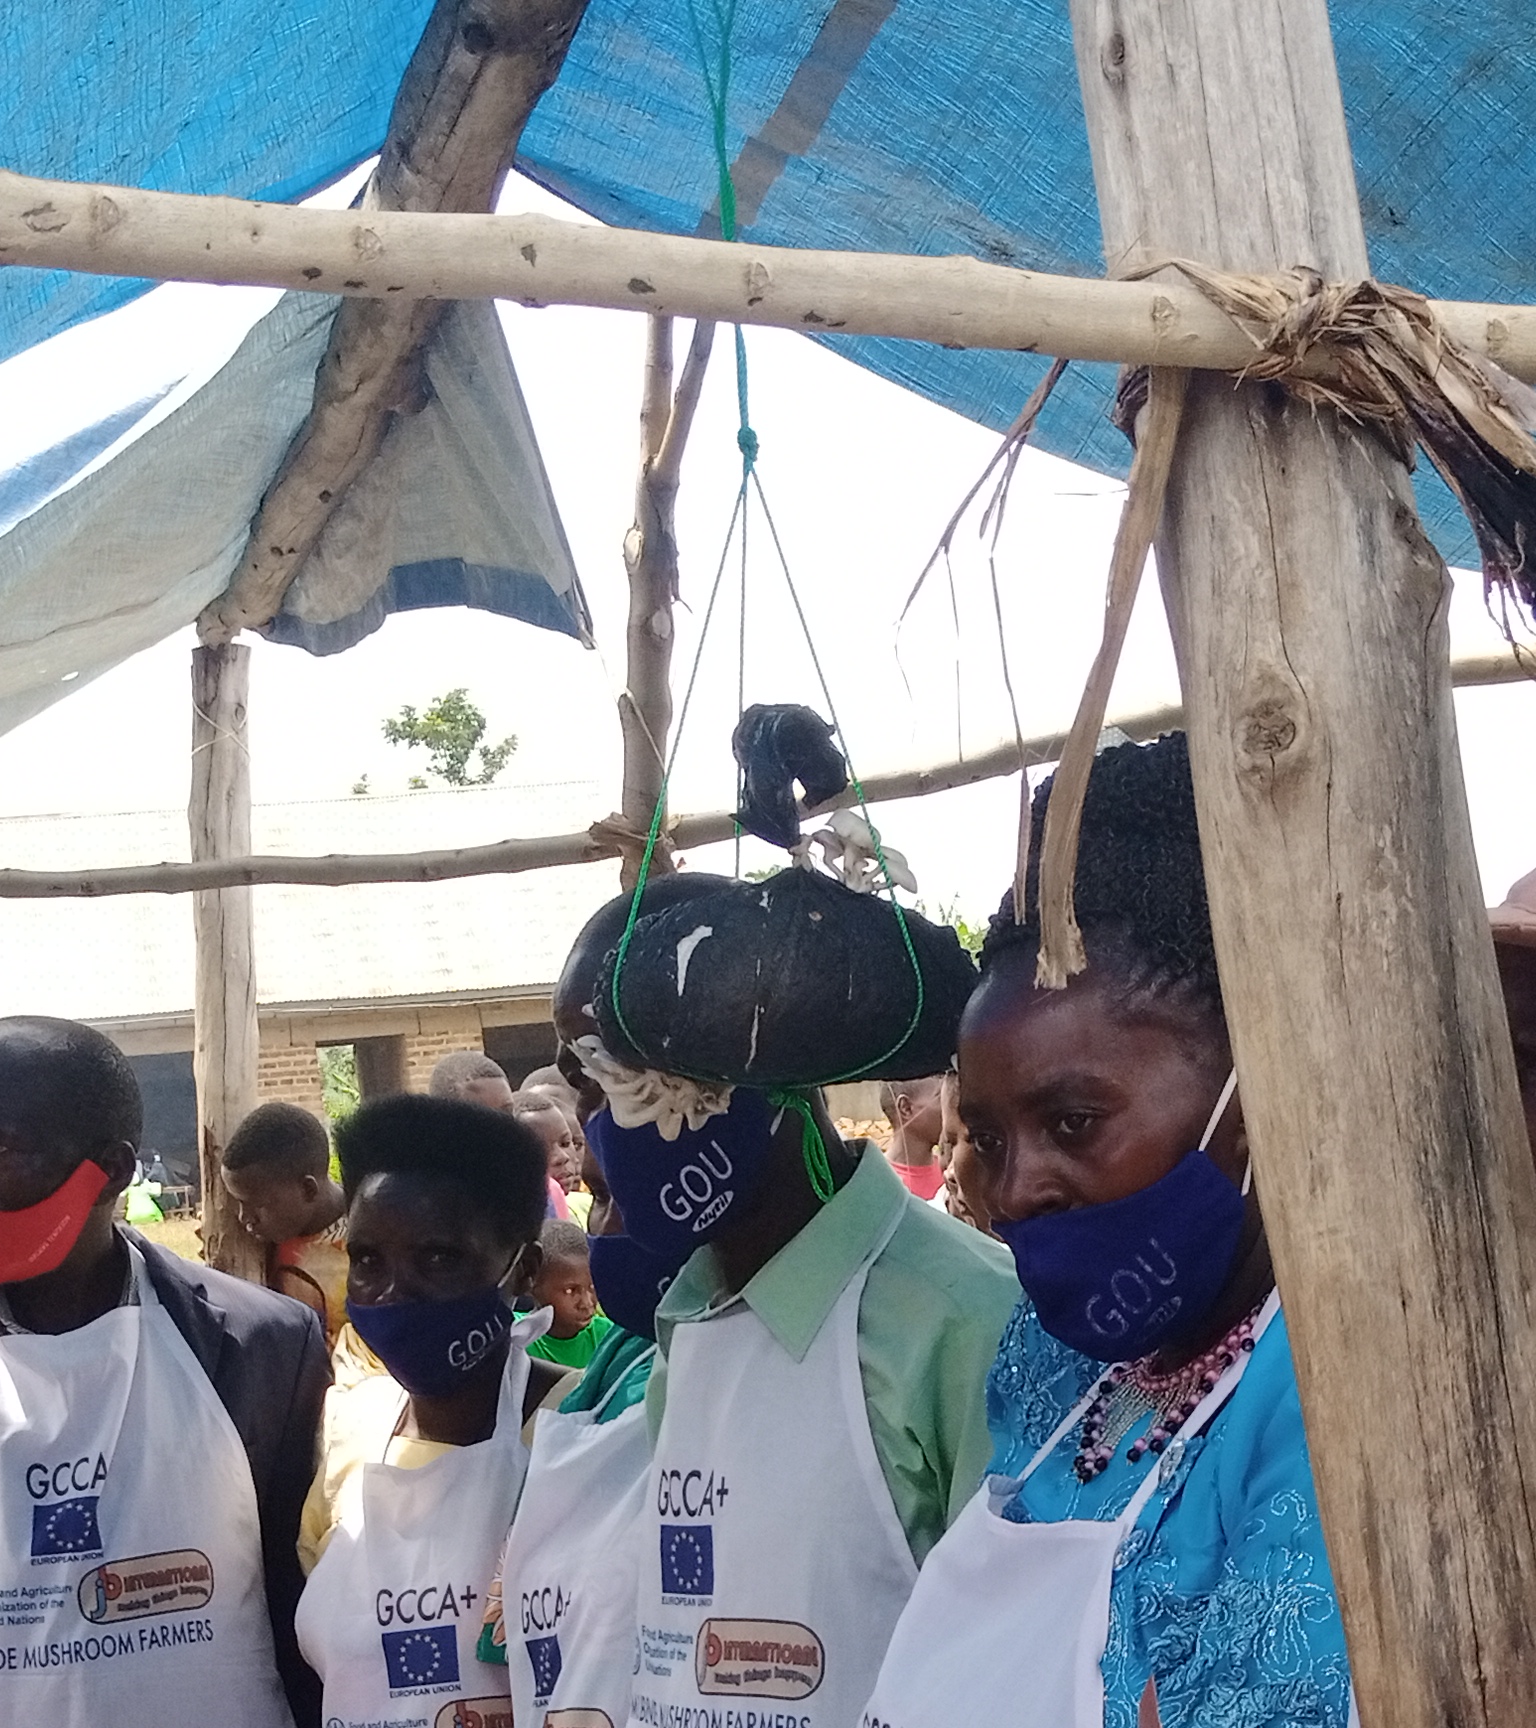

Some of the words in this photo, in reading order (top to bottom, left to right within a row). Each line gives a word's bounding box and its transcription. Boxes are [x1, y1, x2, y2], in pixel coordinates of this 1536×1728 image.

[659, 1140, 733, 1221] GOU
[1086, 1237, 1177, 1337] GOU
[657, 1469, 729, 1518] GCCA+
[31, 1554, 80, 1566] EUROPEAN
[0, 1588, 18, 1598] and
[376, 1582, 477, 1627] GCCA+
[23, 1632, 134, 1669] MUSHROOM
[139, 1619, 214, 1651] FARMERS
[389, 1687, 431, 1699] EUROPEAN
[432, 1683, 462, 1694] UNION
